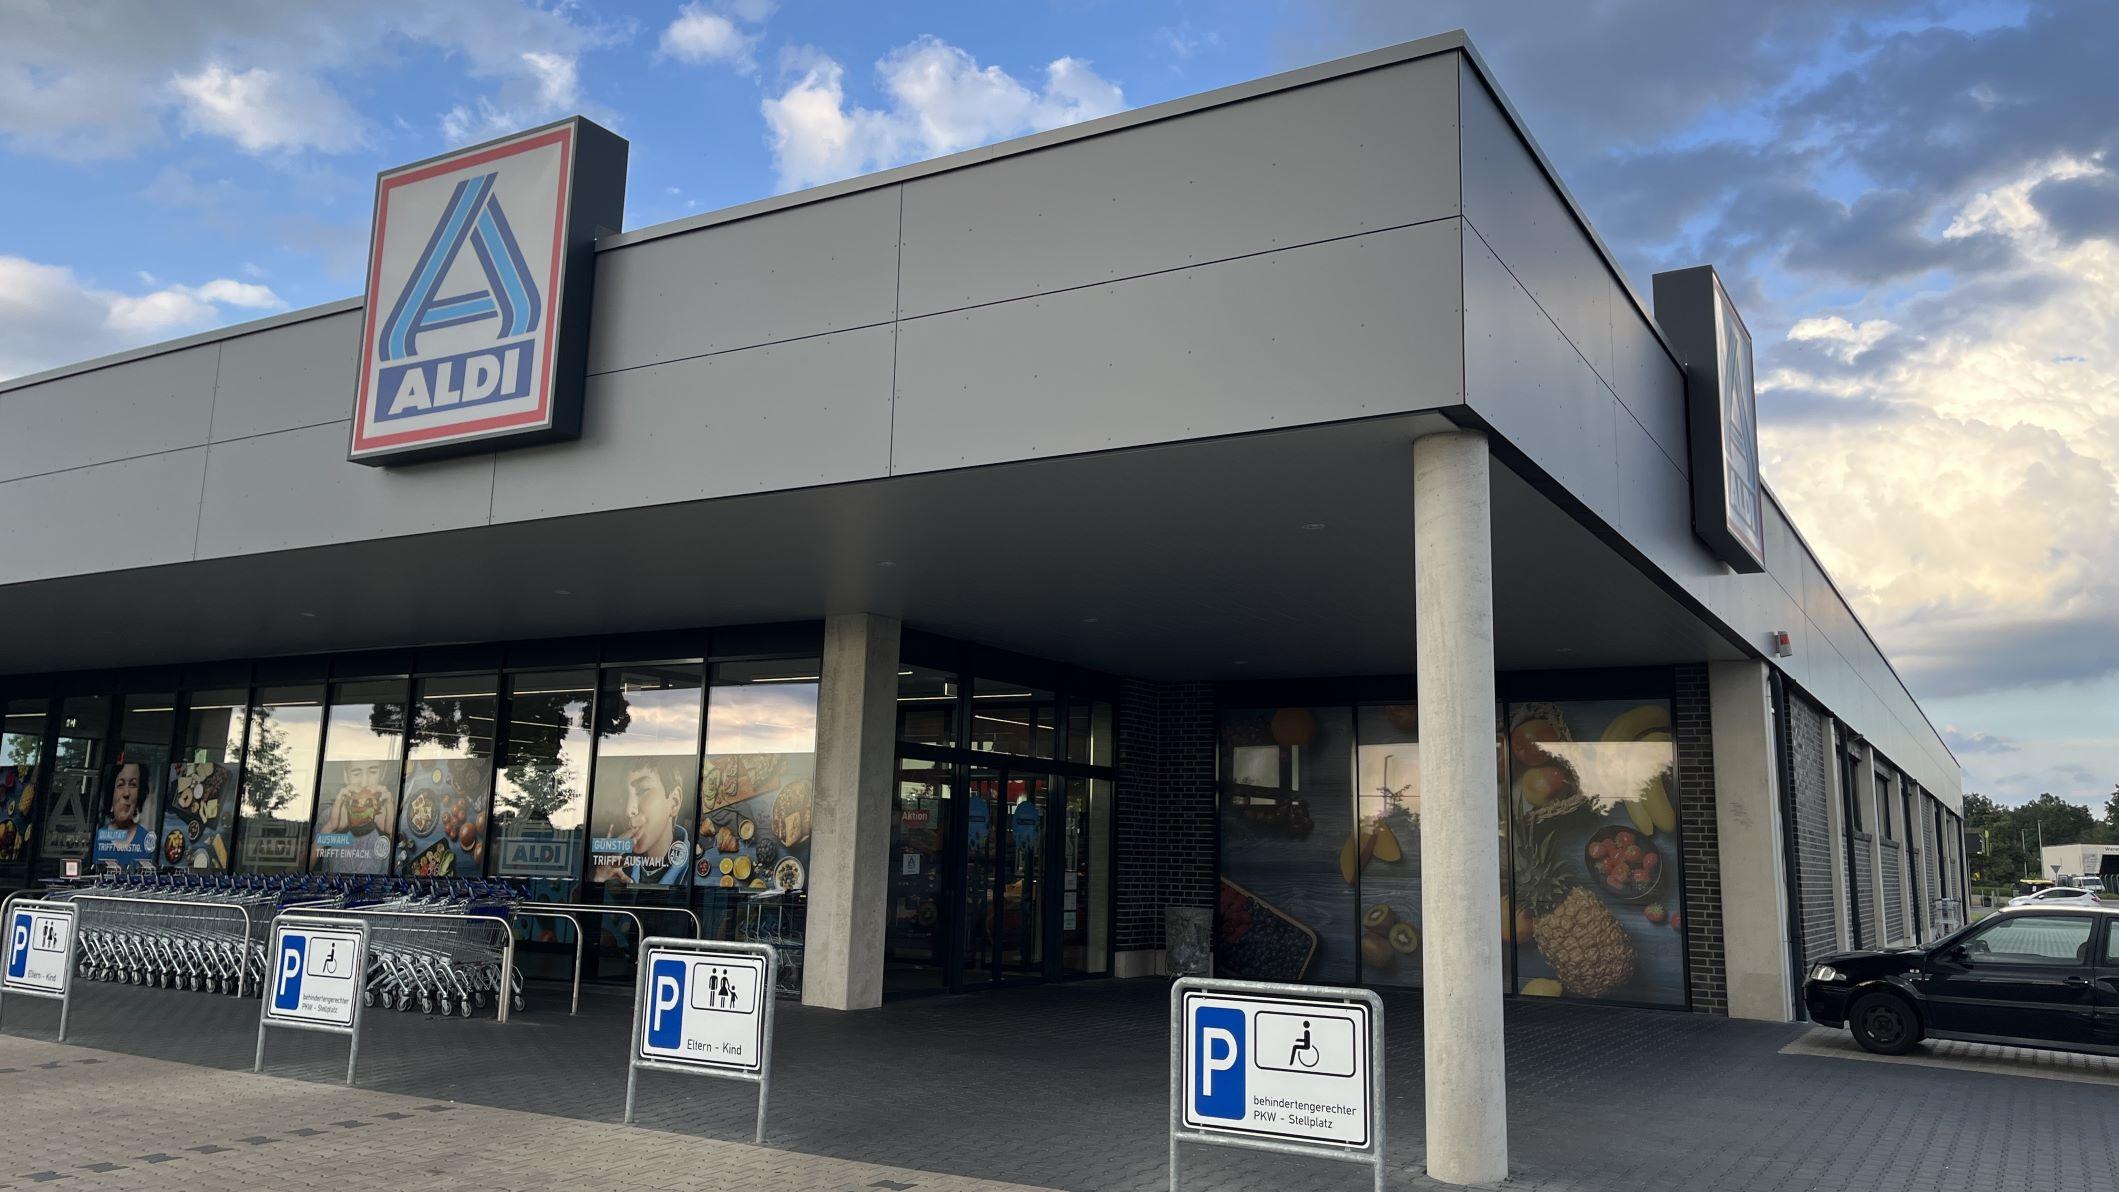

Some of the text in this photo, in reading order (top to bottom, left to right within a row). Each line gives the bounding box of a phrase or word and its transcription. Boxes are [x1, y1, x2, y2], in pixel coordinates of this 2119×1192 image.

[388, 349, 520, 416] ALDI
[902, 811, 928, 821] Aktion
[317, 834, 350, 845] AUSWAHL
[315, 848, 340, 858] TRIFFT
[512, 845, 561, 863] ALDI
[593, 855, 669, 868] TRIFFT AUSWAHL.
[12, 925, 27, 965] P
[280, 948, 301, 996] P
[654, 975, 680, 1032] P
[687, 1039, 712, 1052] Eltern
[723, 1043, 742, 1056] Kind
[1203, 1027, 1238, 1097] P
[1253, 1096, 1357, 1116] behindertengerechter
[1253, 1111, 1276, 1123] PKW
[1288, 1115, 1333, 1129] Stellplatz
